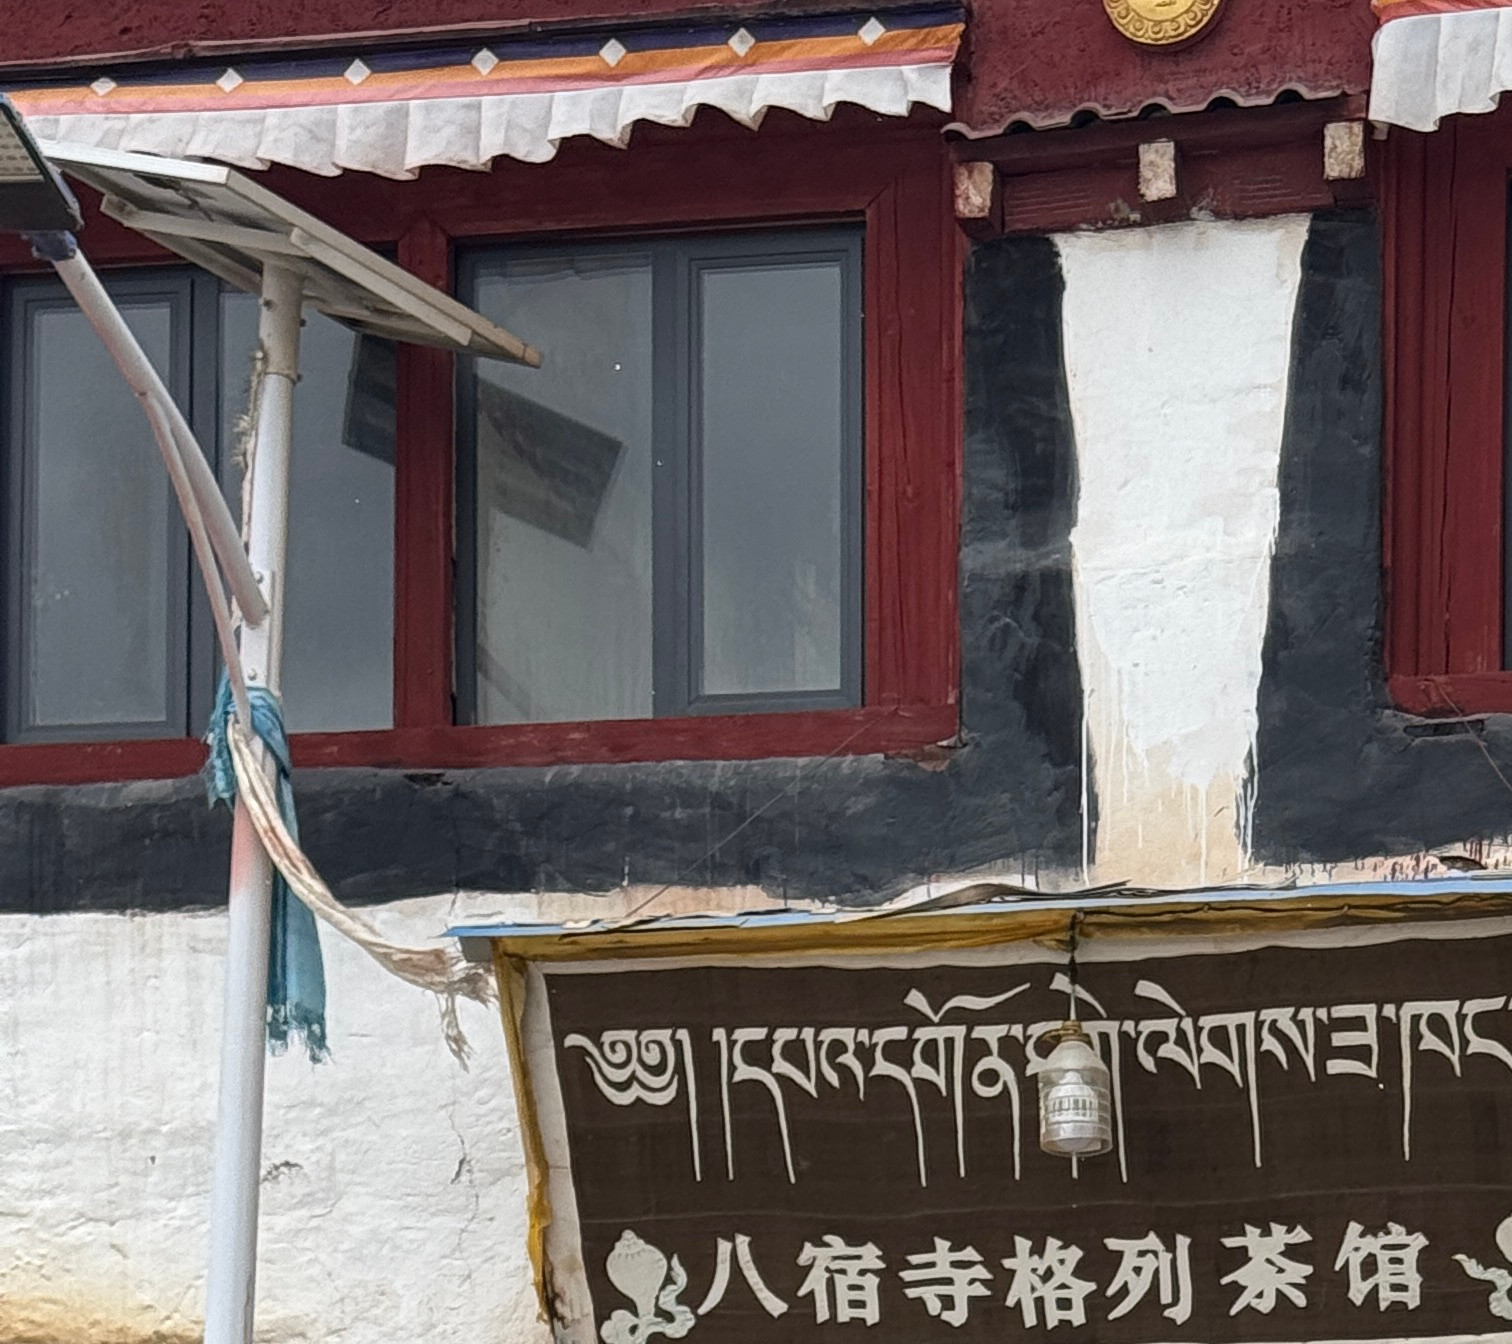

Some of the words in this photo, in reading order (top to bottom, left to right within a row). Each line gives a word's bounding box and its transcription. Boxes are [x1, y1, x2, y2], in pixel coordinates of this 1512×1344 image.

[697, 1222, 1429, 1330] 八宿寺格列茶馆
